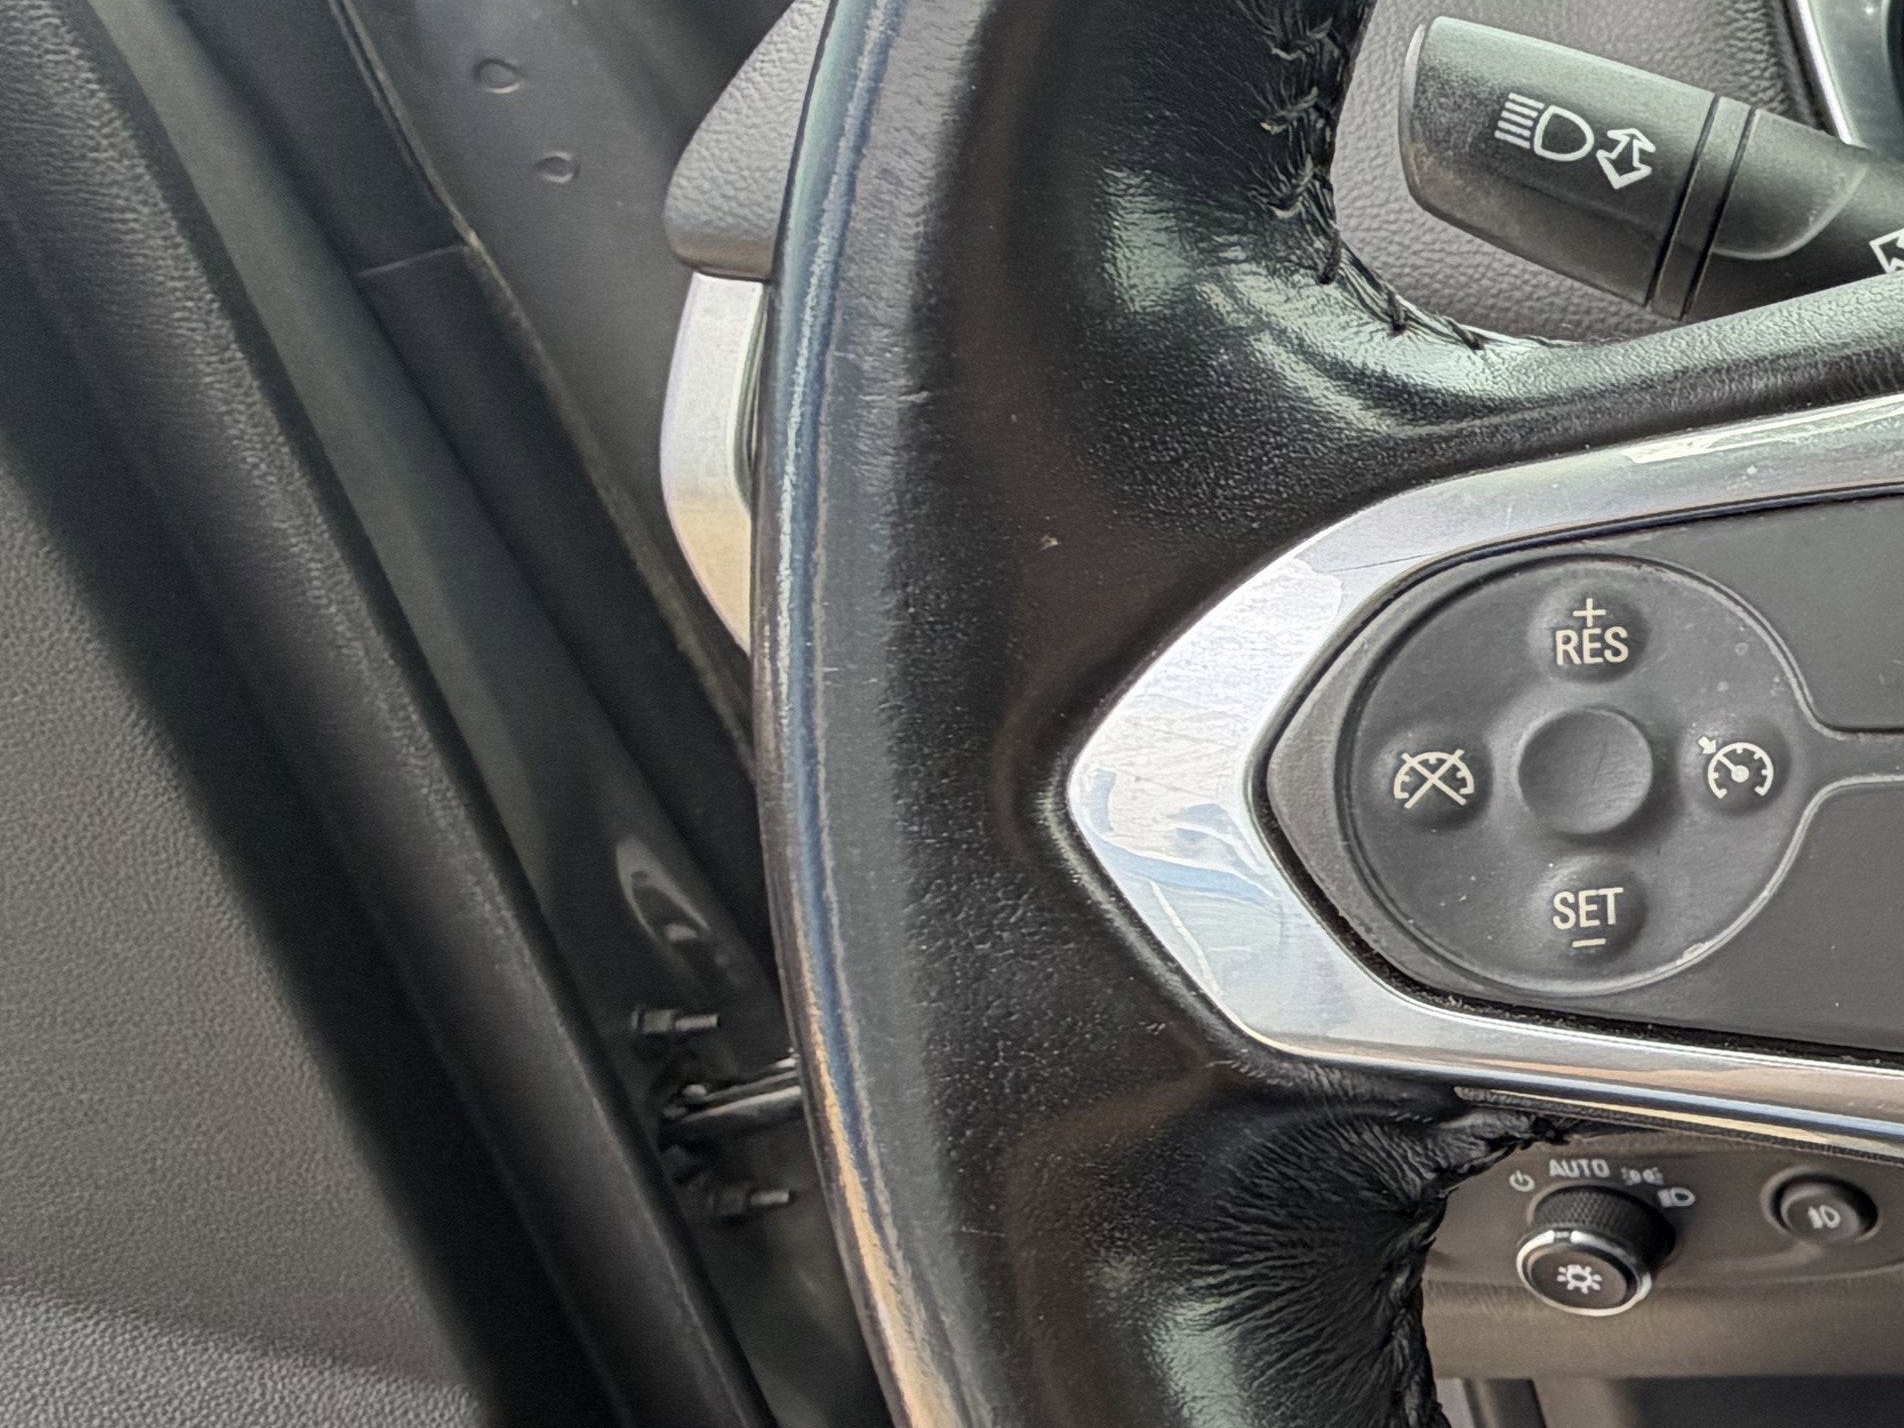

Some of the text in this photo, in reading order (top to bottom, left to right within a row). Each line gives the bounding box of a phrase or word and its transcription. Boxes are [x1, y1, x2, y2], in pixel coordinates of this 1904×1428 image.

[1556, 628, 1629, 665] RES
[1552, 887, 1623, 930] SET
[1549, 1158, 1610, 1179] AUTO
